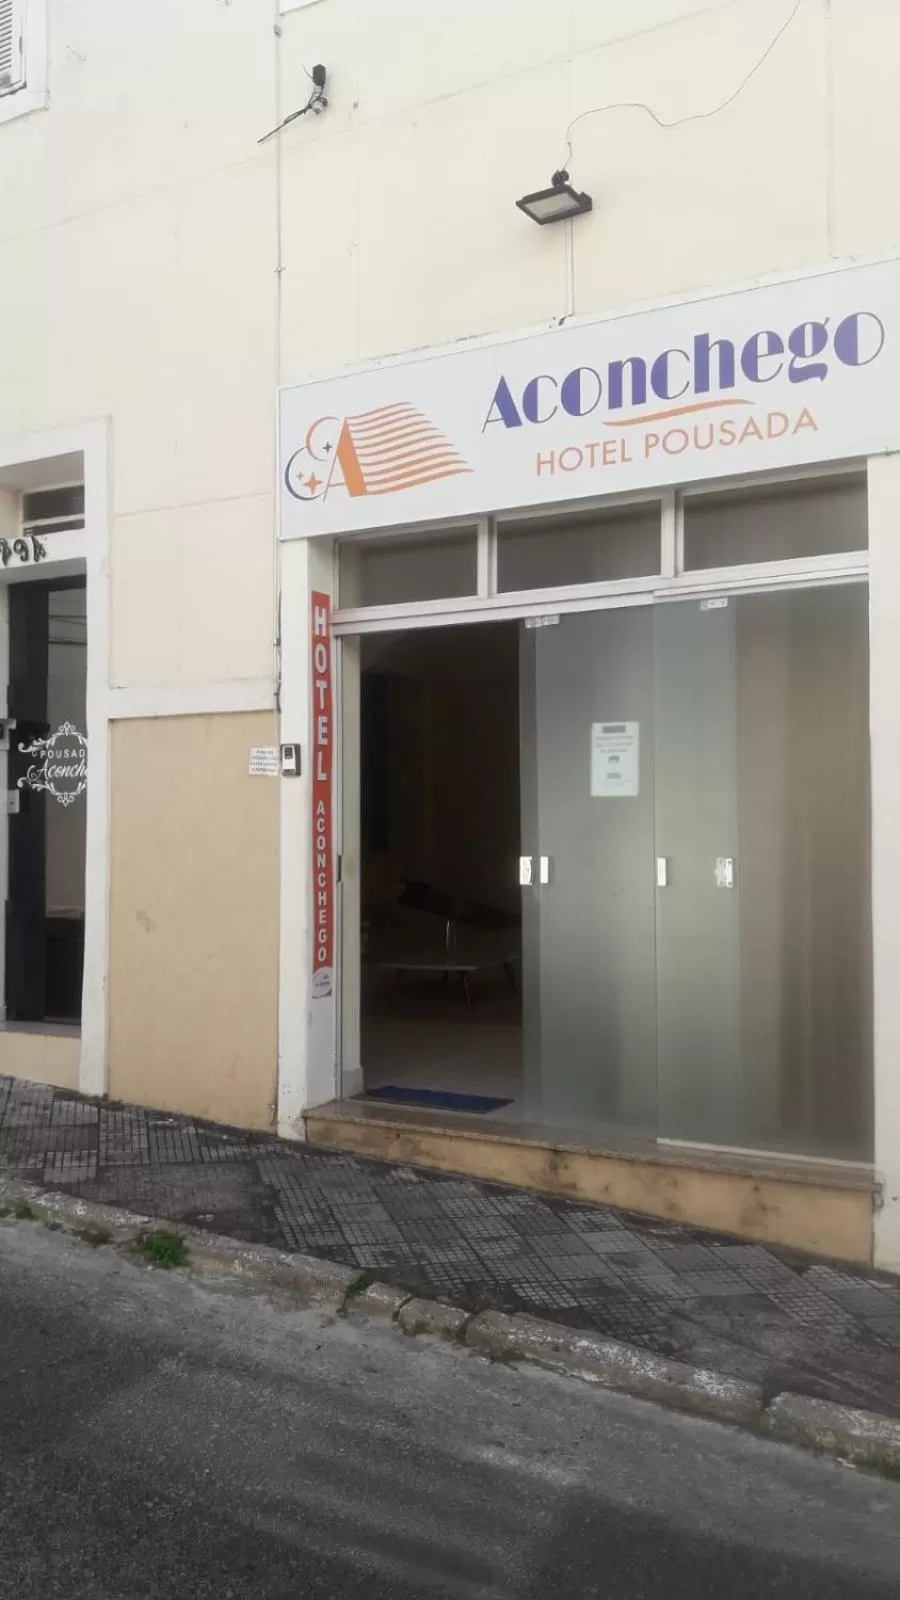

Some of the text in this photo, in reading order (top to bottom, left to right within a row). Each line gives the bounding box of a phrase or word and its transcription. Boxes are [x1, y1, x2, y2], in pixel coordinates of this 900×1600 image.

[481, 311, 886, 433] Aconchego
[535, 407, 819, 477] HOTEL POUSADA
[40, 749, 86, 759] POUSAD
[314, 605, 329, 782] HOTEL
[316, 800, 328, 962] ACONCHEGO
